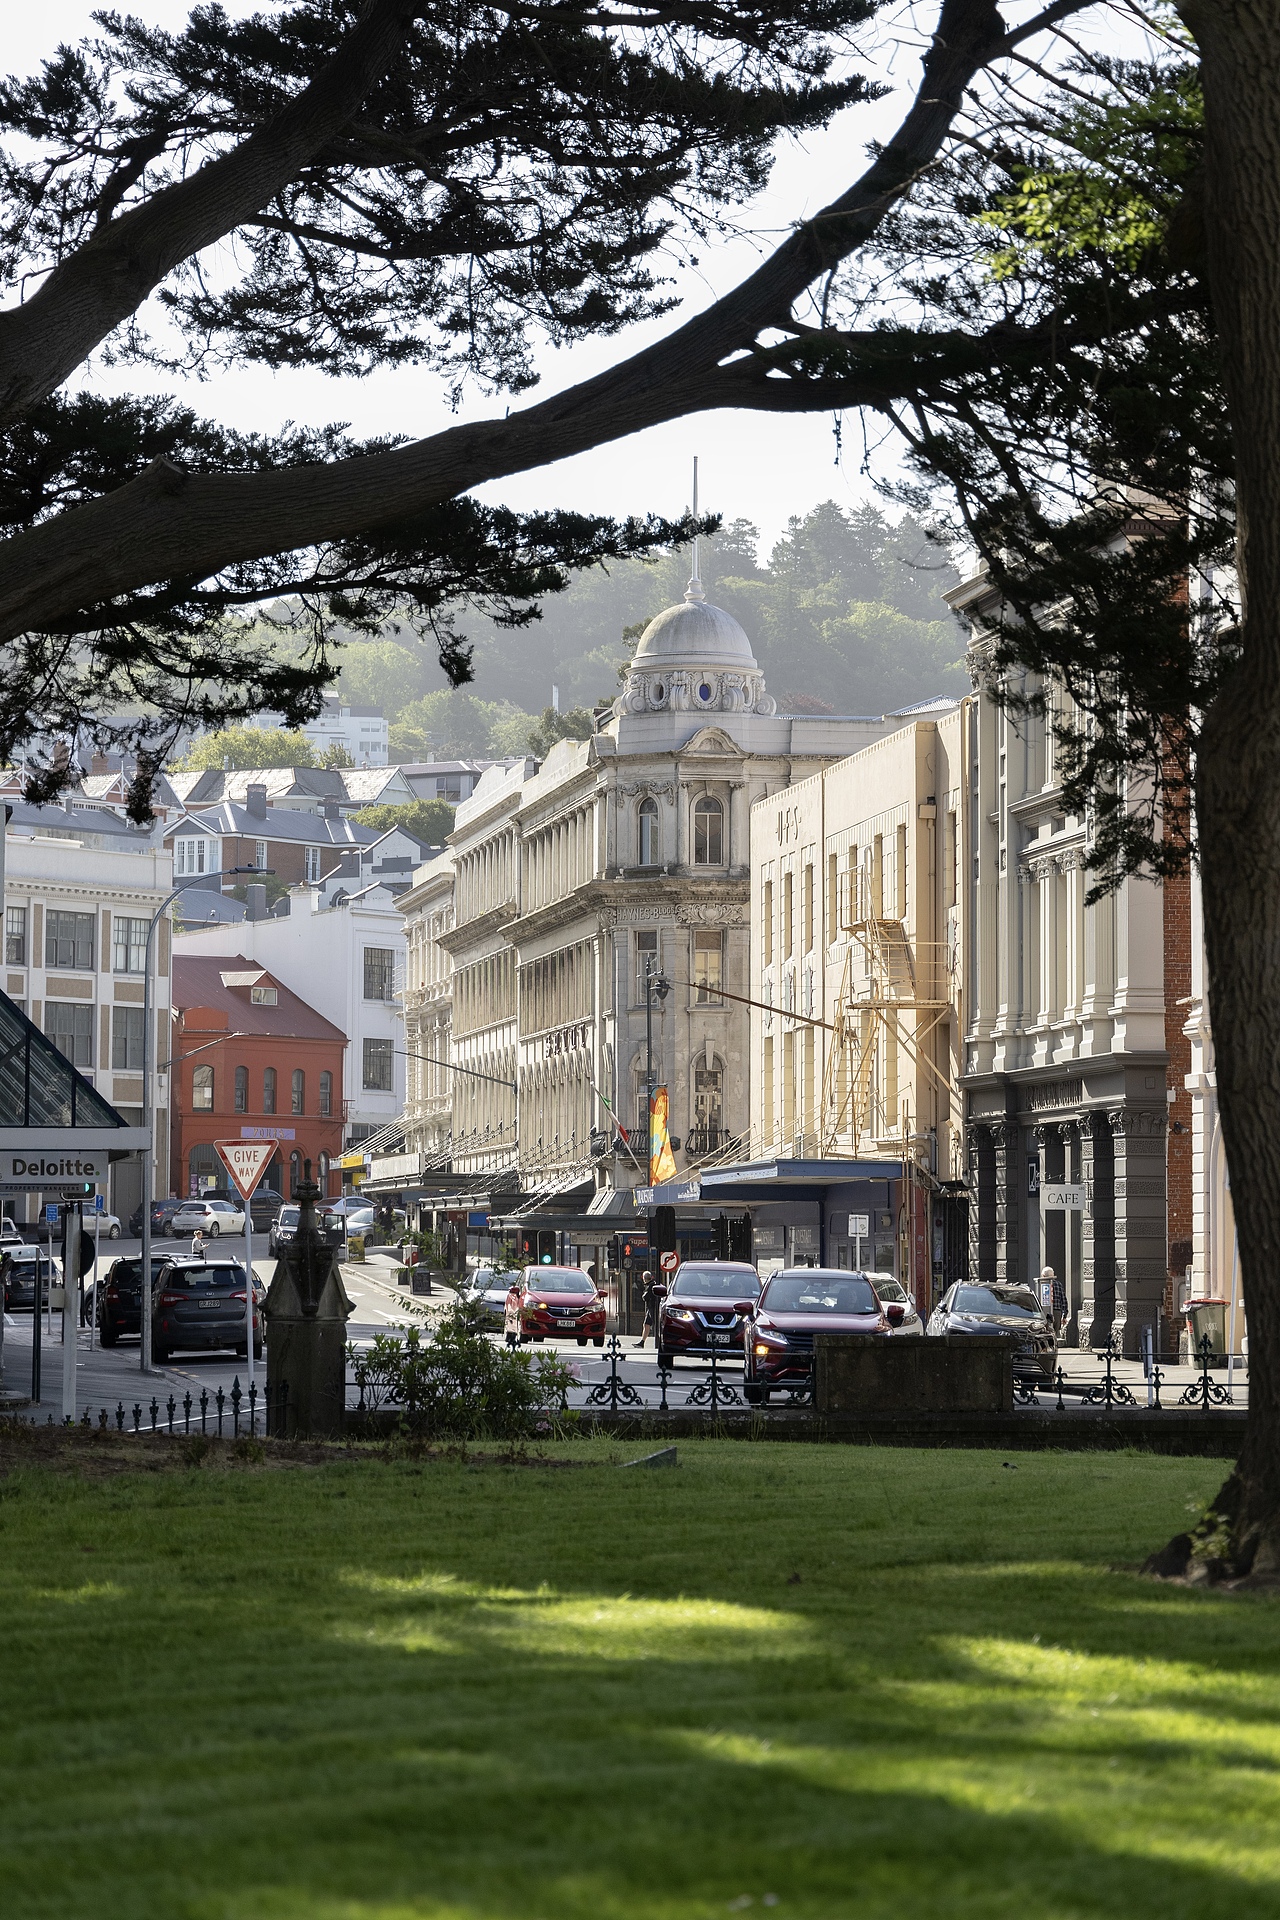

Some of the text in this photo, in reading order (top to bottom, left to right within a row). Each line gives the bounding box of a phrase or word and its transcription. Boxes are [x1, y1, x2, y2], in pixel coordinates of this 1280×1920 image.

[234, 1150, 259, 1163] GIVE
[12, 1158, 100, 1177] Deloitte.
[239, 1167, 255, 1177] WAY
[1047, 1193, 1079, 1204] CAFE
[1043, 1285, 1049, 1295] P
